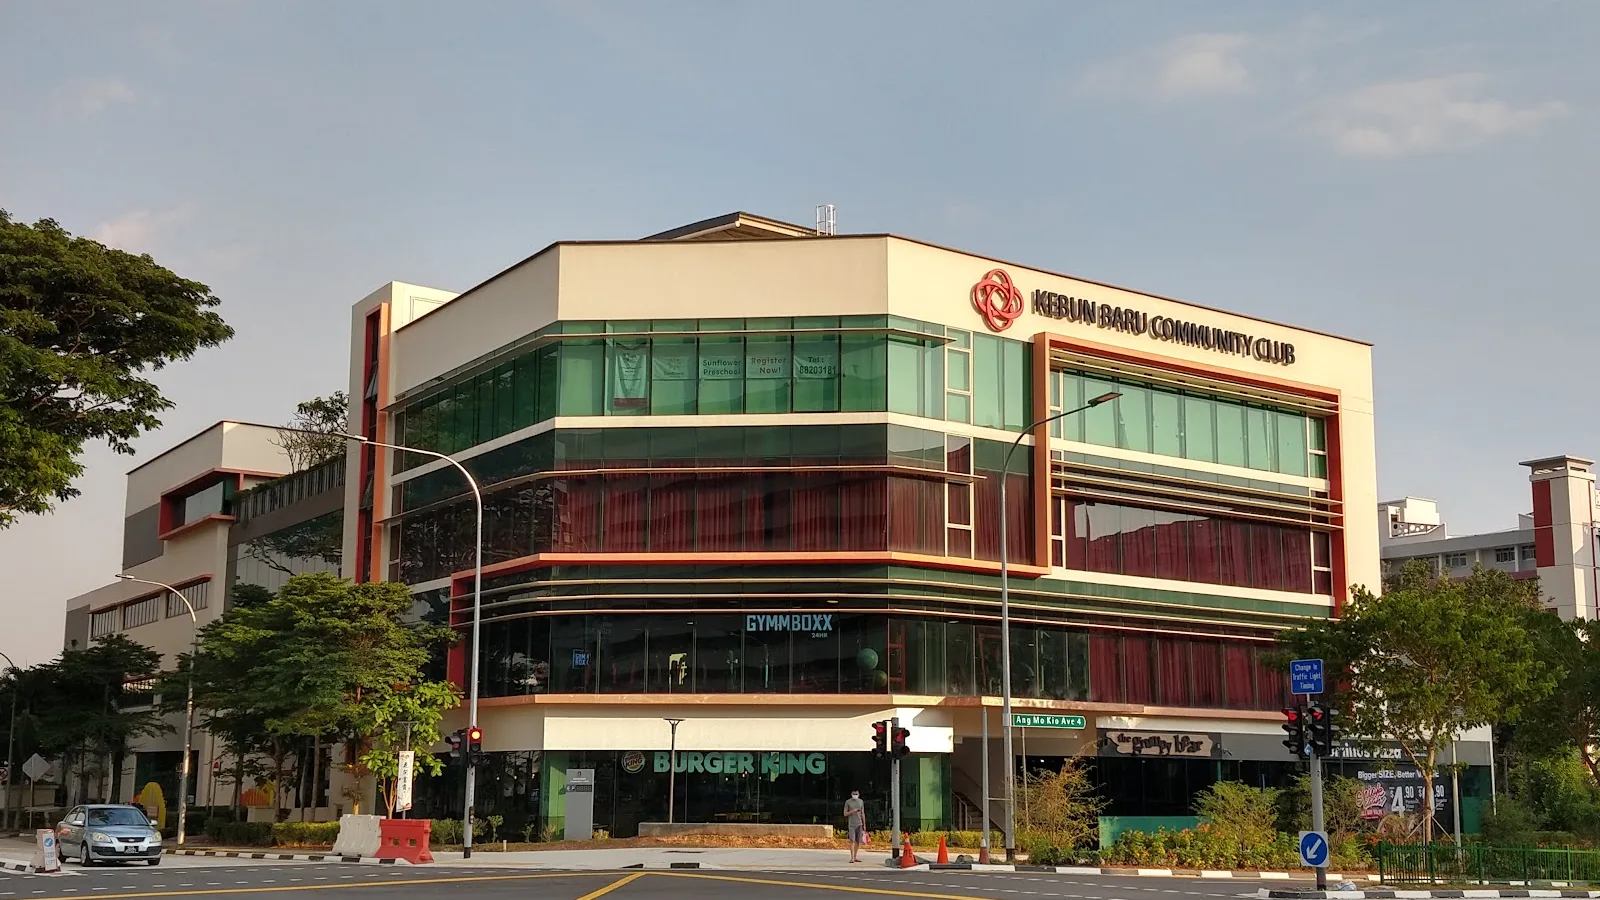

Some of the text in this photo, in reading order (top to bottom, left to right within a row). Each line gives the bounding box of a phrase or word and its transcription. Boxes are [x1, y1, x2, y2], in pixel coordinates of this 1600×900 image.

[1033, 288, 1295, 366] KEBUN BARU COMMUNITY CLUB
[703, 359, 742, 367] Sunflower
[751, 357, 787, 366] Register
[703, 368, 741, 376] Preschool
[799, 365, 837, 375] 88203181
[1295, 664, 1311, 672] Change
[1292, 672, 1321, 681] Traffic Light
[1300, 682, 1314, 691] Timing
[1016, 716, 1031, 725] Ang
[1033, 716, 1045, 724] Mo
[1046, 716, 1059, 725] Kio
[1061, 717, 1074, 725] Ave
[1117, 733, 1203, 756] the grumpy bear
[625, 758, 643, 768] KING
[653, 752, 825, 774] BURGER KING
[1357, 770, 1377, 780] Bigger
[1397, 770, 1415, 778] Better
